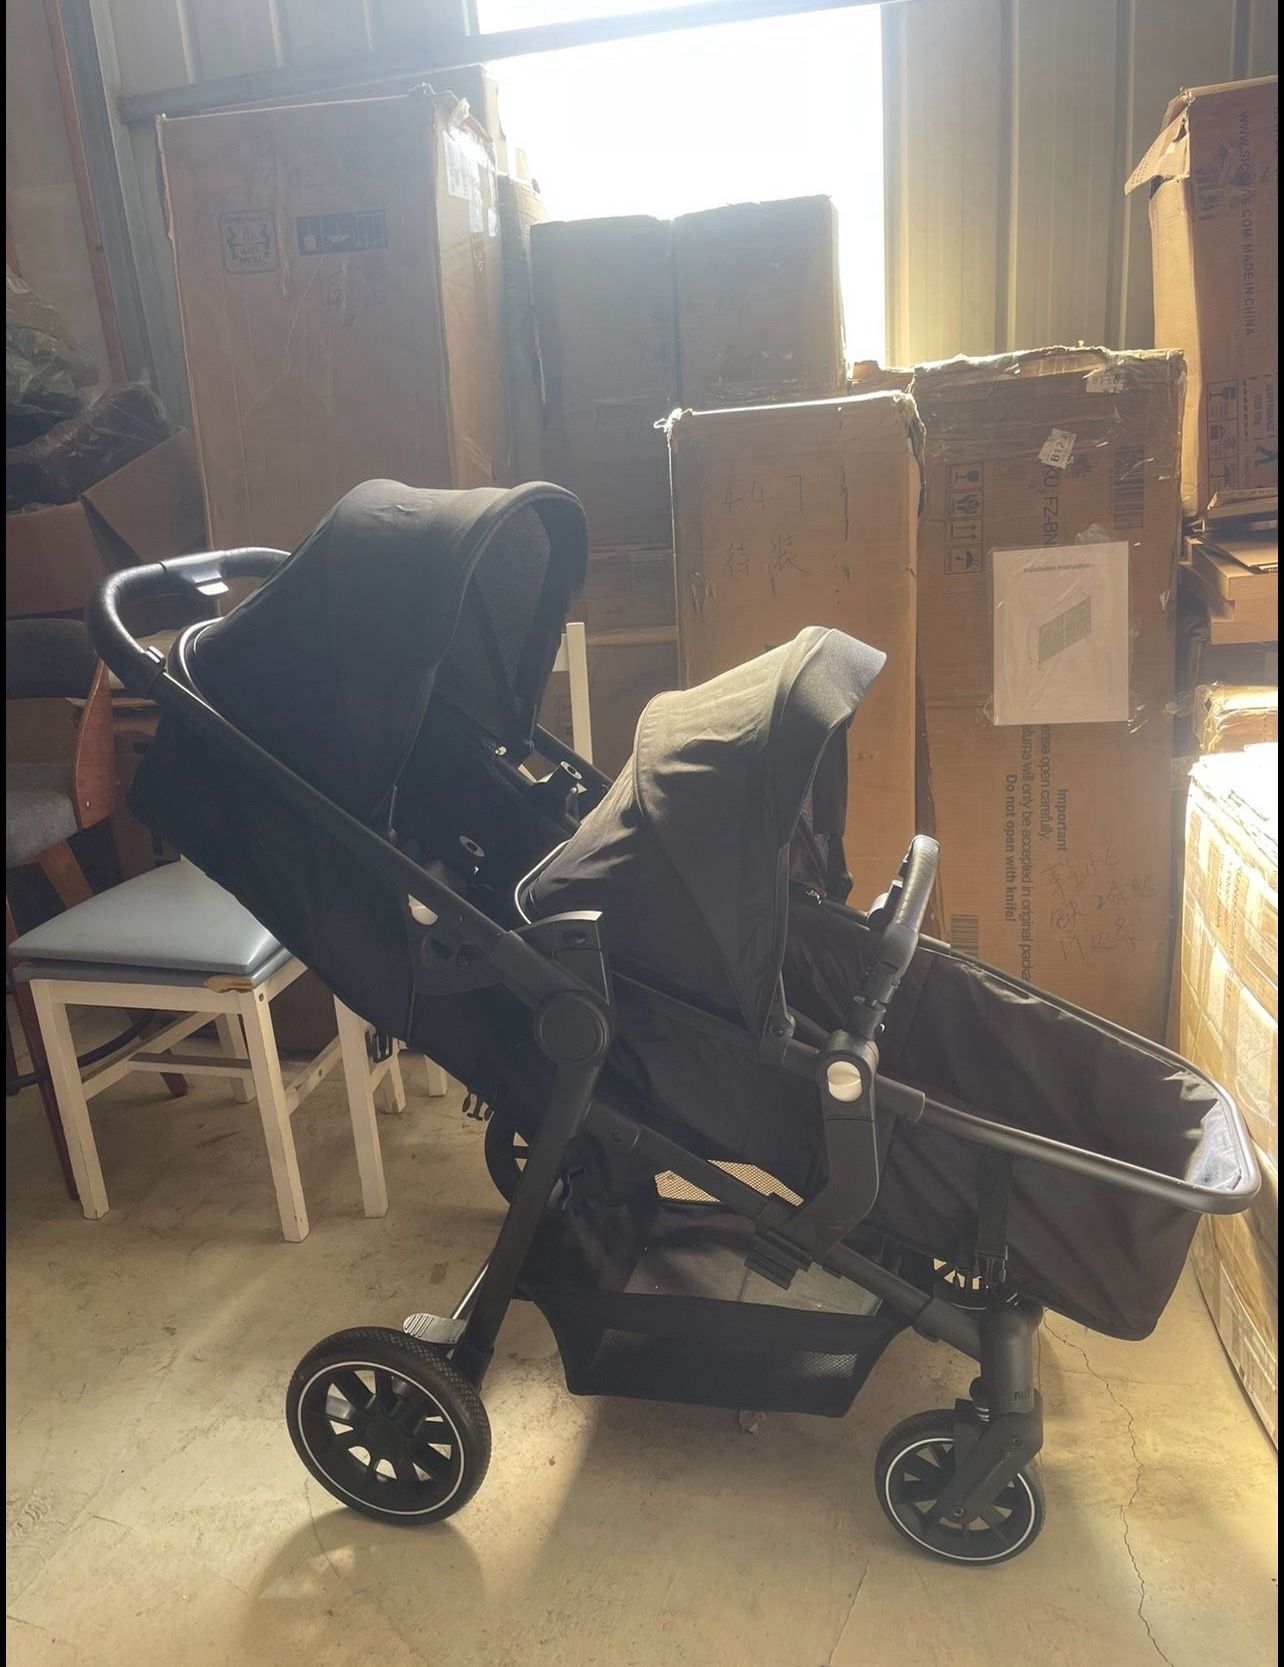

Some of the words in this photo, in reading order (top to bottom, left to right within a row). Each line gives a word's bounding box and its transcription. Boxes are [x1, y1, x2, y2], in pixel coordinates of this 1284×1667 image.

[1243, 244, 1255, 282] MADE
[1244, 282, 1255, 294] IN
[1244, 297, 1256, 336] CHINA
[1005, 774, 1017, 791] Do
[1022, 763, 1033, 780] will
[1038, 756, 1051, 787] open
[1005, 797, 1016, 816] not
[1019, 783, 1034, 807] only
[1022, 811, 1034, 826] be
[1038, 790, 1052, 841] carefully.
[1056, 789, 1068, 852] Important
[1003, 820, 1015, 852] open
[1005, 859, 1017, 882] with
[1019, 829, 1034, 883] accepted
[1005, 886, 1017, 922] knife!
[1022, 886, 1034, 896] in
[1019, 899, 1034, 942] original
